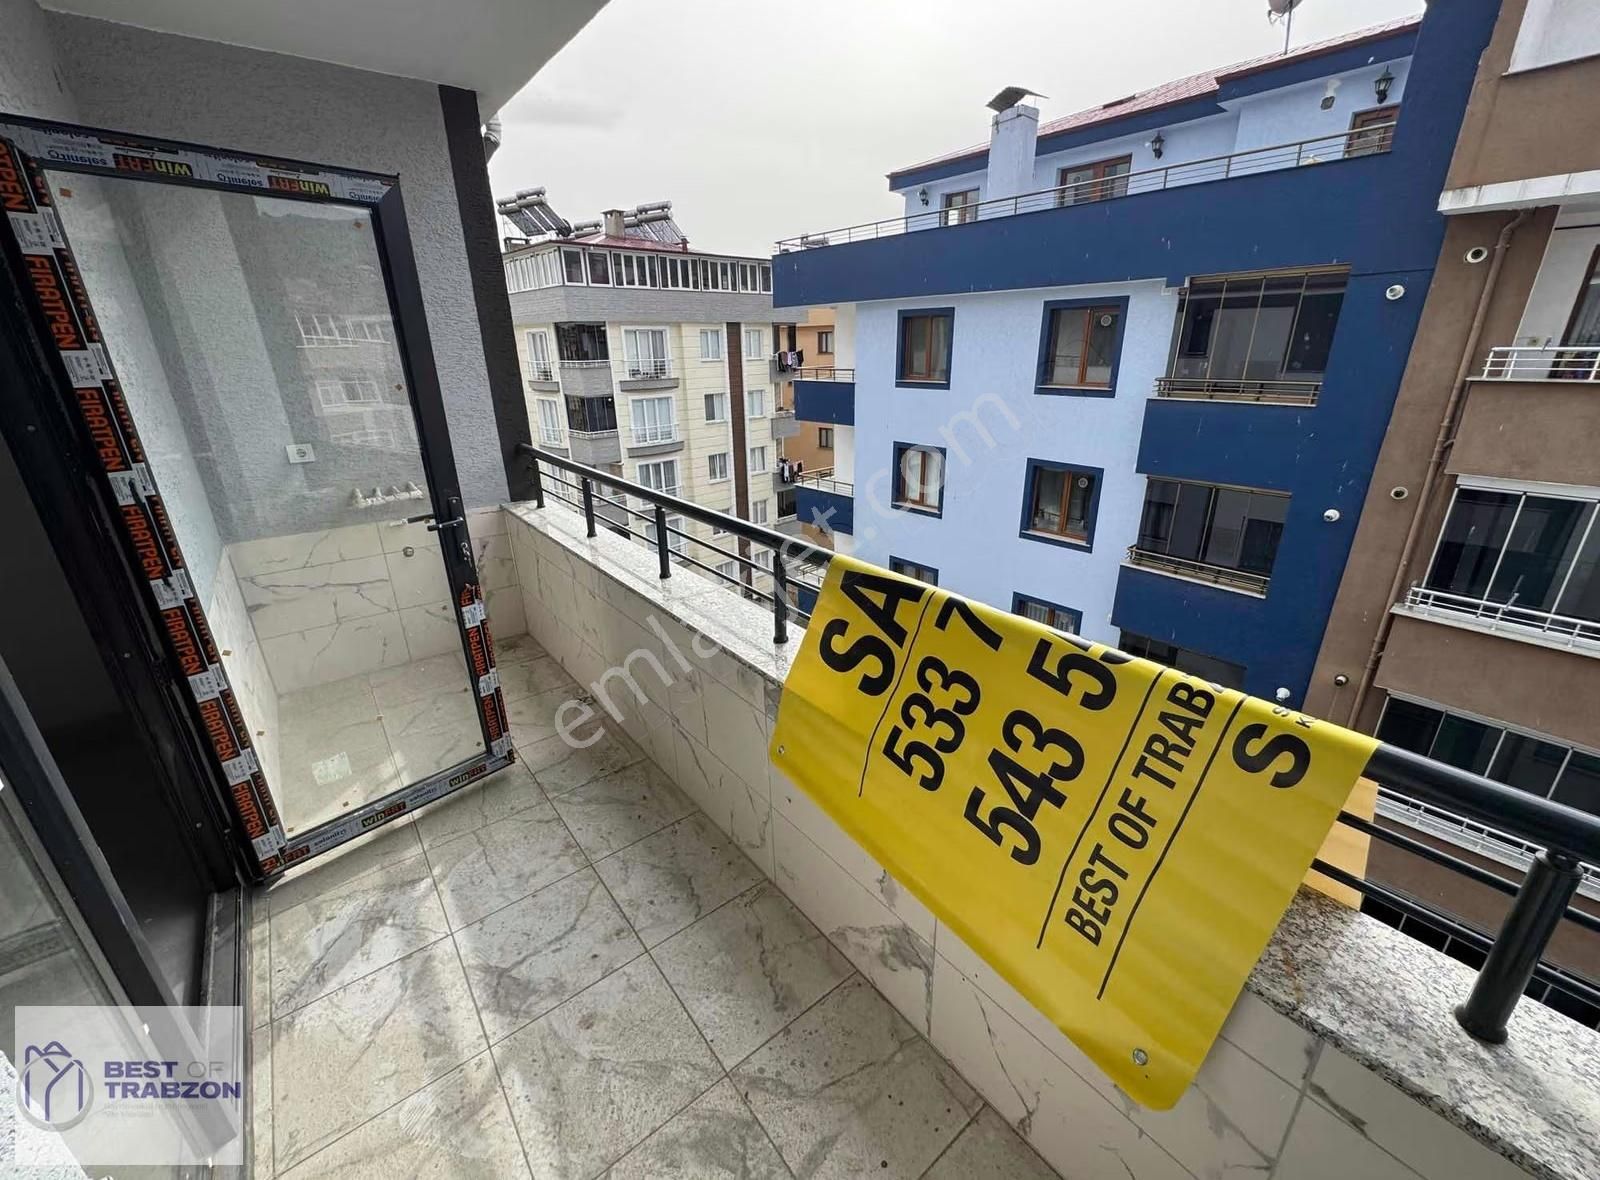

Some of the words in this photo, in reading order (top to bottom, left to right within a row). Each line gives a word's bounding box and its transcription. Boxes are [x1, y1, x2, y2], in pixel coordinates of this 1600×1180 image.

[24, 256, 80, 350] FIRATPEN
[76, 388, 126, 471] FIRATPEN
[121, 505, 164, 579] FIRATPEN
[163, 608, 203, 676] FIRATPEN
[200, 700, 238, 762] FIRATPEN
[882, 655, 981, 792] 533
[1131, 681, 1224, 790] TRAB
[231, 783, 266, 840] FIRATPEN
[963, 709, 1086, 866] 543
[1107, 787, 1158, 850] OF
[1064, 842, 1130, 948] BEST
